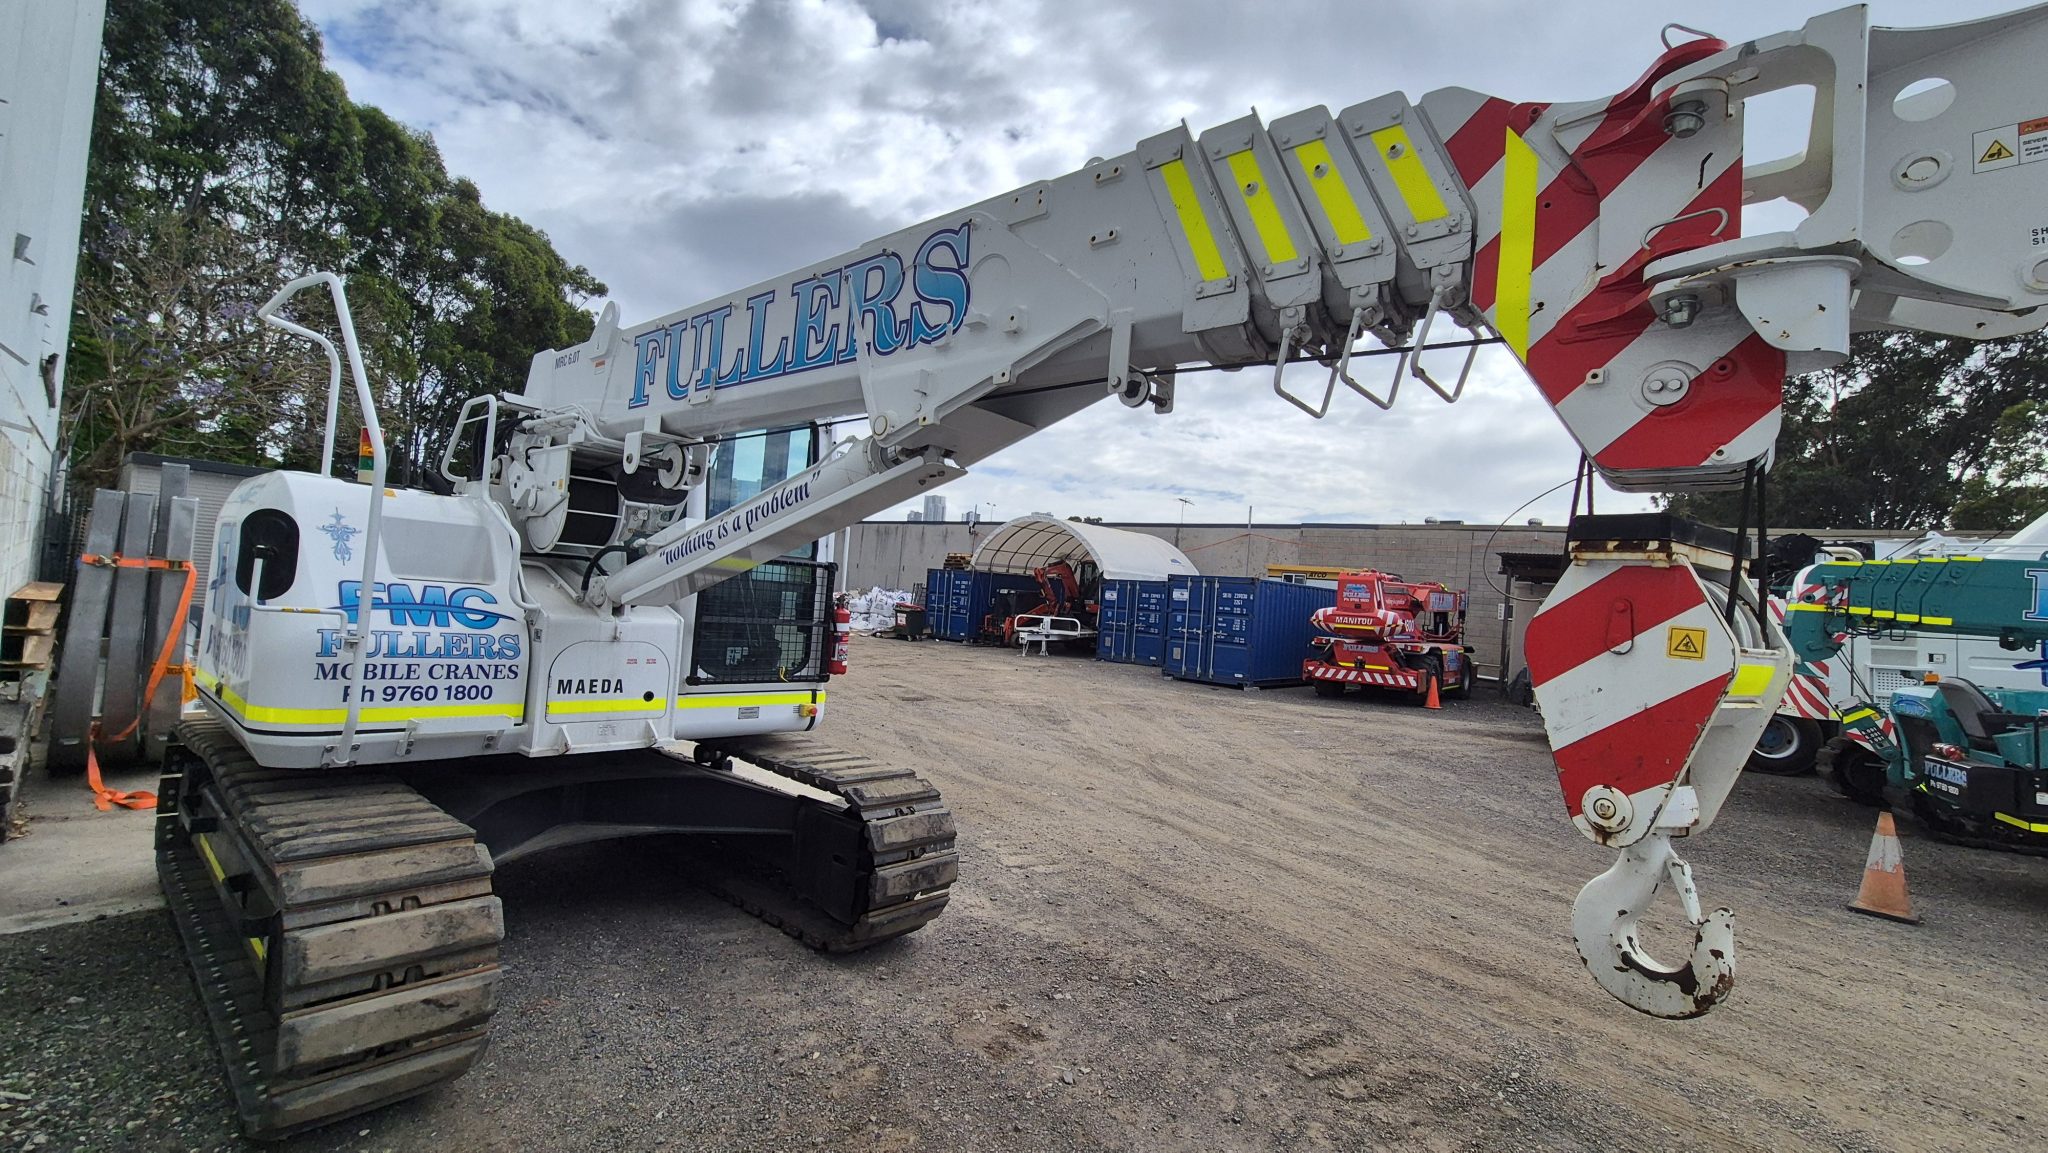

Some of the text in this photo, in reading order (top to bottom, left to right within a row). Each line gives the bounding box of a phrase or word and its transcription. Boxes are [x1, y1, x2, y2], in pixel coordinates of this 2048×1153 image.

[628, 221, 972, 410] FULLERS
[554, 350, 581, 371] MRC 6.0T
[717, 517, 729, 540] is
[732, 514, 742, 532] a
[1308, 571, 1328, 579] ATCO
[338, 580, 501, 630] FMC
[1335, 616, 1374, 626] MANITOU
[314, 662, 519, 681] MOBILE CRANES
[382, 685, 439, 702] 9760
[443, 684, 494, 701] 1800
[557, 678, 625, 695] MAEDA
[1924, 761, 1968, 786] FULLERS
